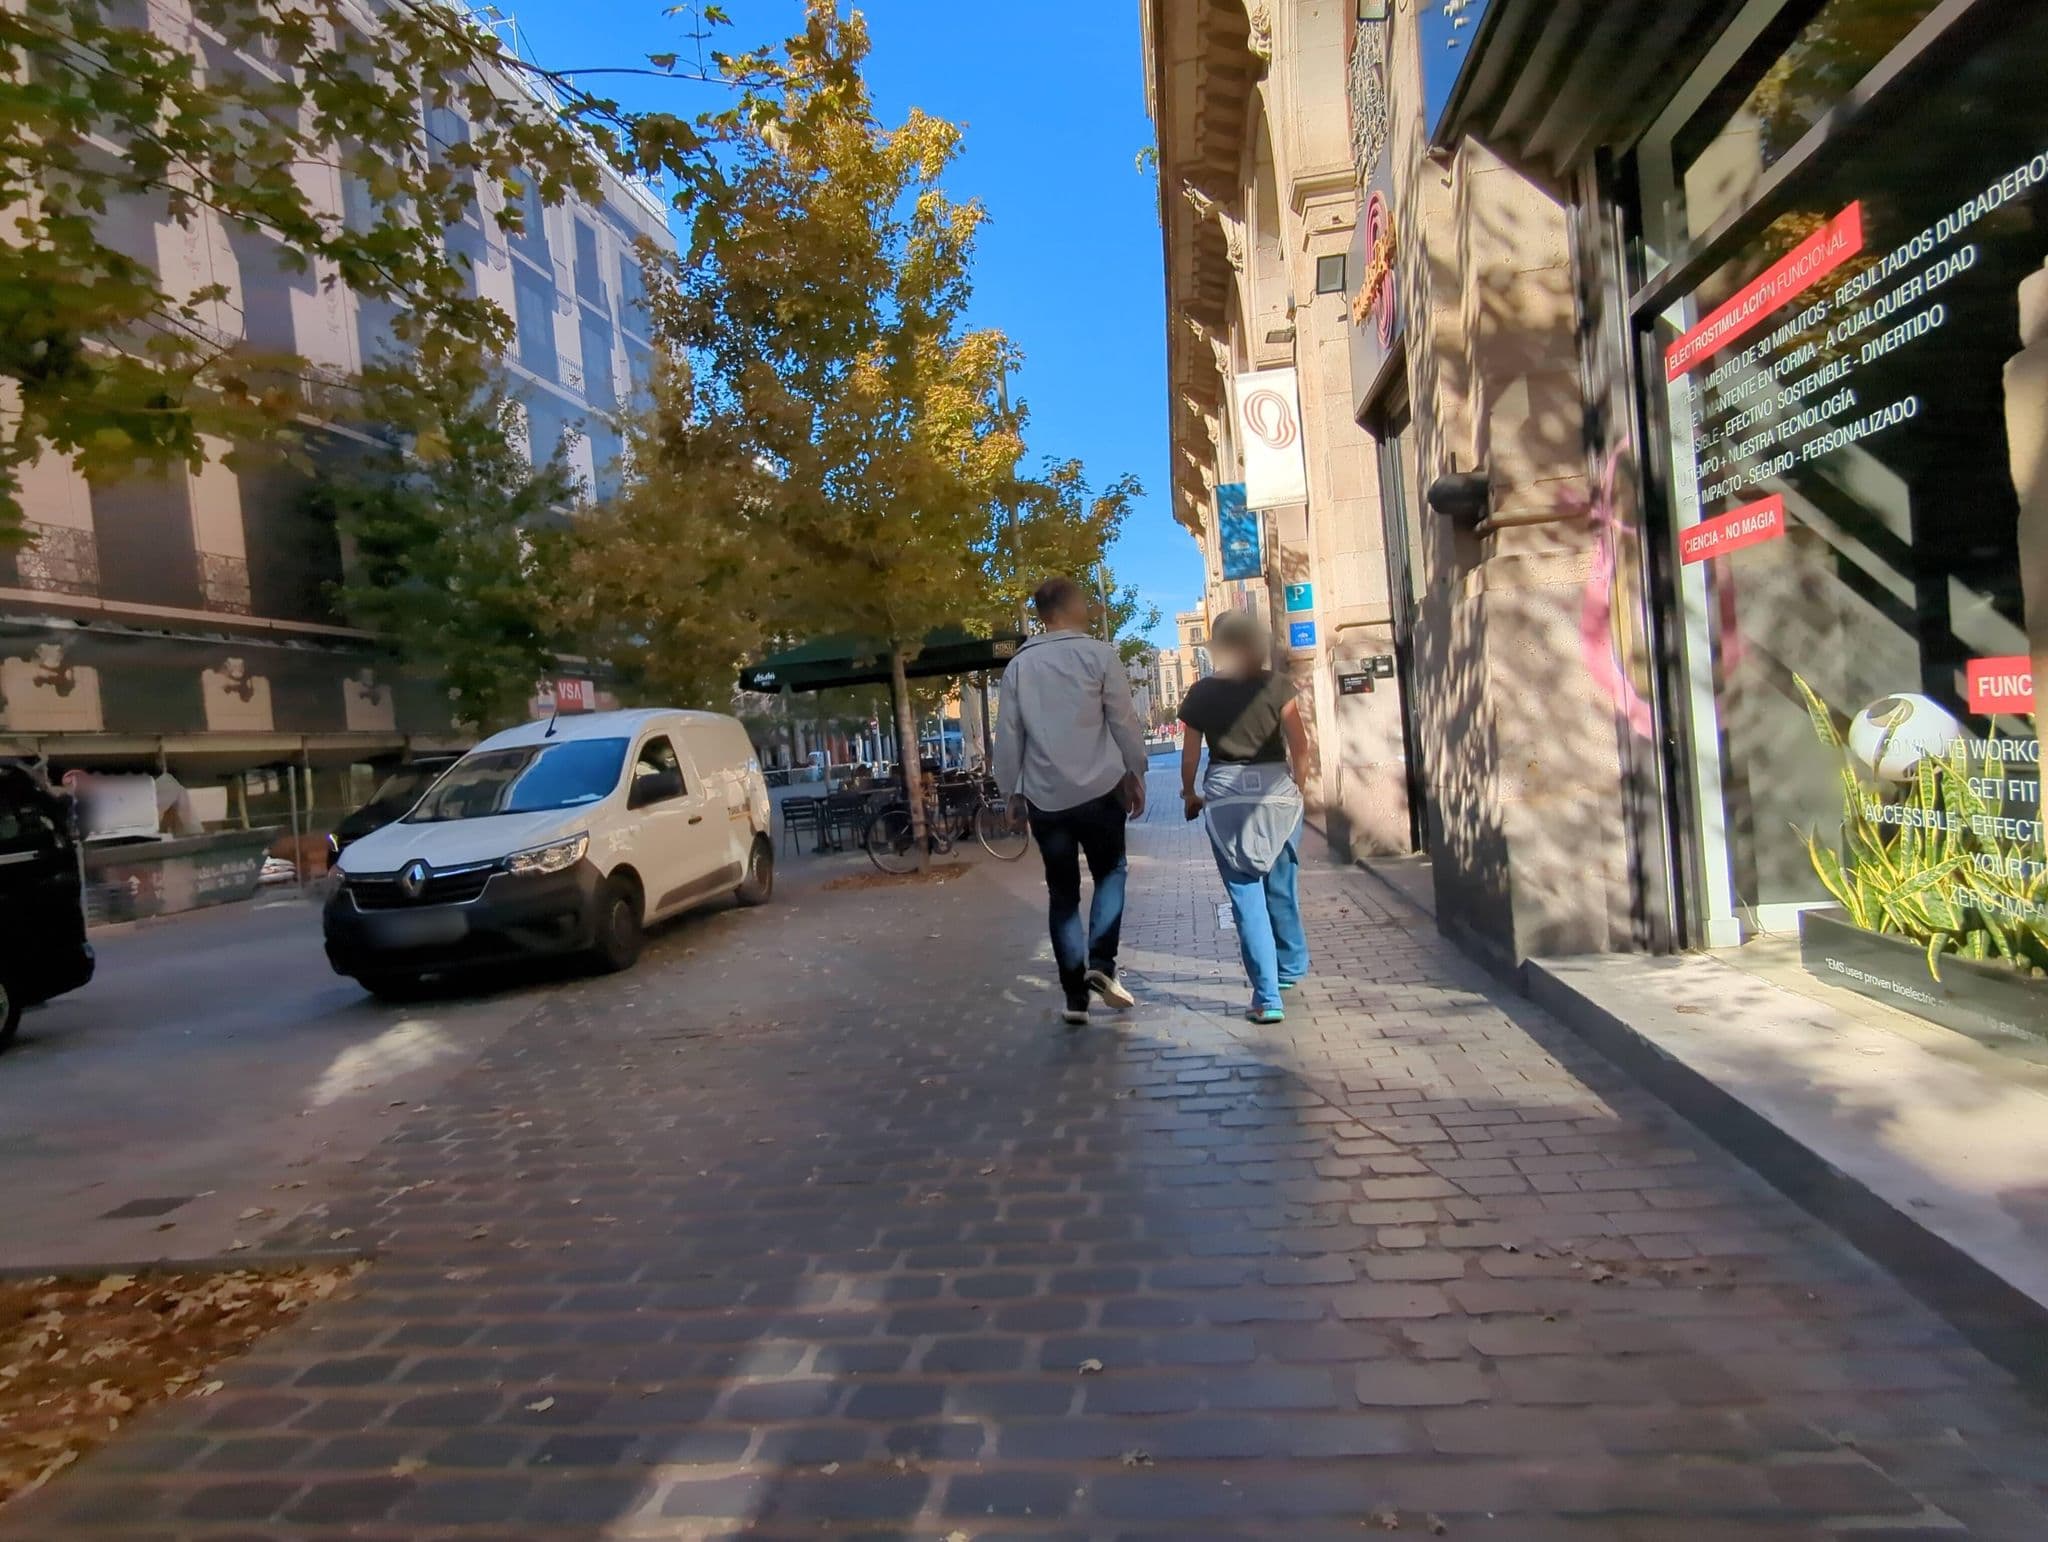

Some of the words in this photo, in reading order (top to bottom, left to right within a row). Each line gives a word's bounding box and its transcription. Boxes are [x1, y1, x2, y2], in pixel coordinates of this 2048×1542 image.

[1742, 345, 1757, 368] DE
[1757, 337, 1771, 358] 30
[1772, 300, 1826, 349] MINUTOS
[1835, 228, 1933, 309] RESULTADOS
[1936, 151, 2048, 243] DURADERO
[1670, 280, 1776, 370] ELECTROSTIMULACIÓN
[1777, 229, 1848, 292] FUNCIONAL
[1706, 376, 1757, 418] MANTENTE
[1758, 366, 1772, 389] EN
[1774, 342, 1816, 379] FORMA
[1825, 330, 1835, 350] A
[1837, 276, 1922, 342] CUALQUIER
[1925, 244, 1975, 291] EDAD
[1725, 398, 1773, 437] EFECTIVO
[1777, 354, 1852, 409] SOSTENIBLE
[1861, 304, 1944, 365] DIVERTIDO
[1701, 474, 1742, 504] IMPACTO
[1749, 451, 1793, 485] SEGURO
[1802, 396, 1917, 462] PERSONALIZADO
[1729, 429, 1775, 464] NUESTRA
[1776, 387, 1855, 442] TECNOLOGÍA
[1685, 532, 1719, 554] CIENCIA
[1725, 522, 1740, 541] NO
[1742, 510, 1777, 534] MAGIA
[1294, 586, 1305, 601] P
[1865, 803, 1957, 832] ACCESSIBLE
[1968, 777, 2005, 800] GET
[2008, 779, 2038, 803] FIT
[1969, 851, 2023, 881] YOUR
[1845, 966, 1863, 980] uses
[1864, 973, 1891, 991] proven
[1892, 980, 1936, 1007] bioelectric
